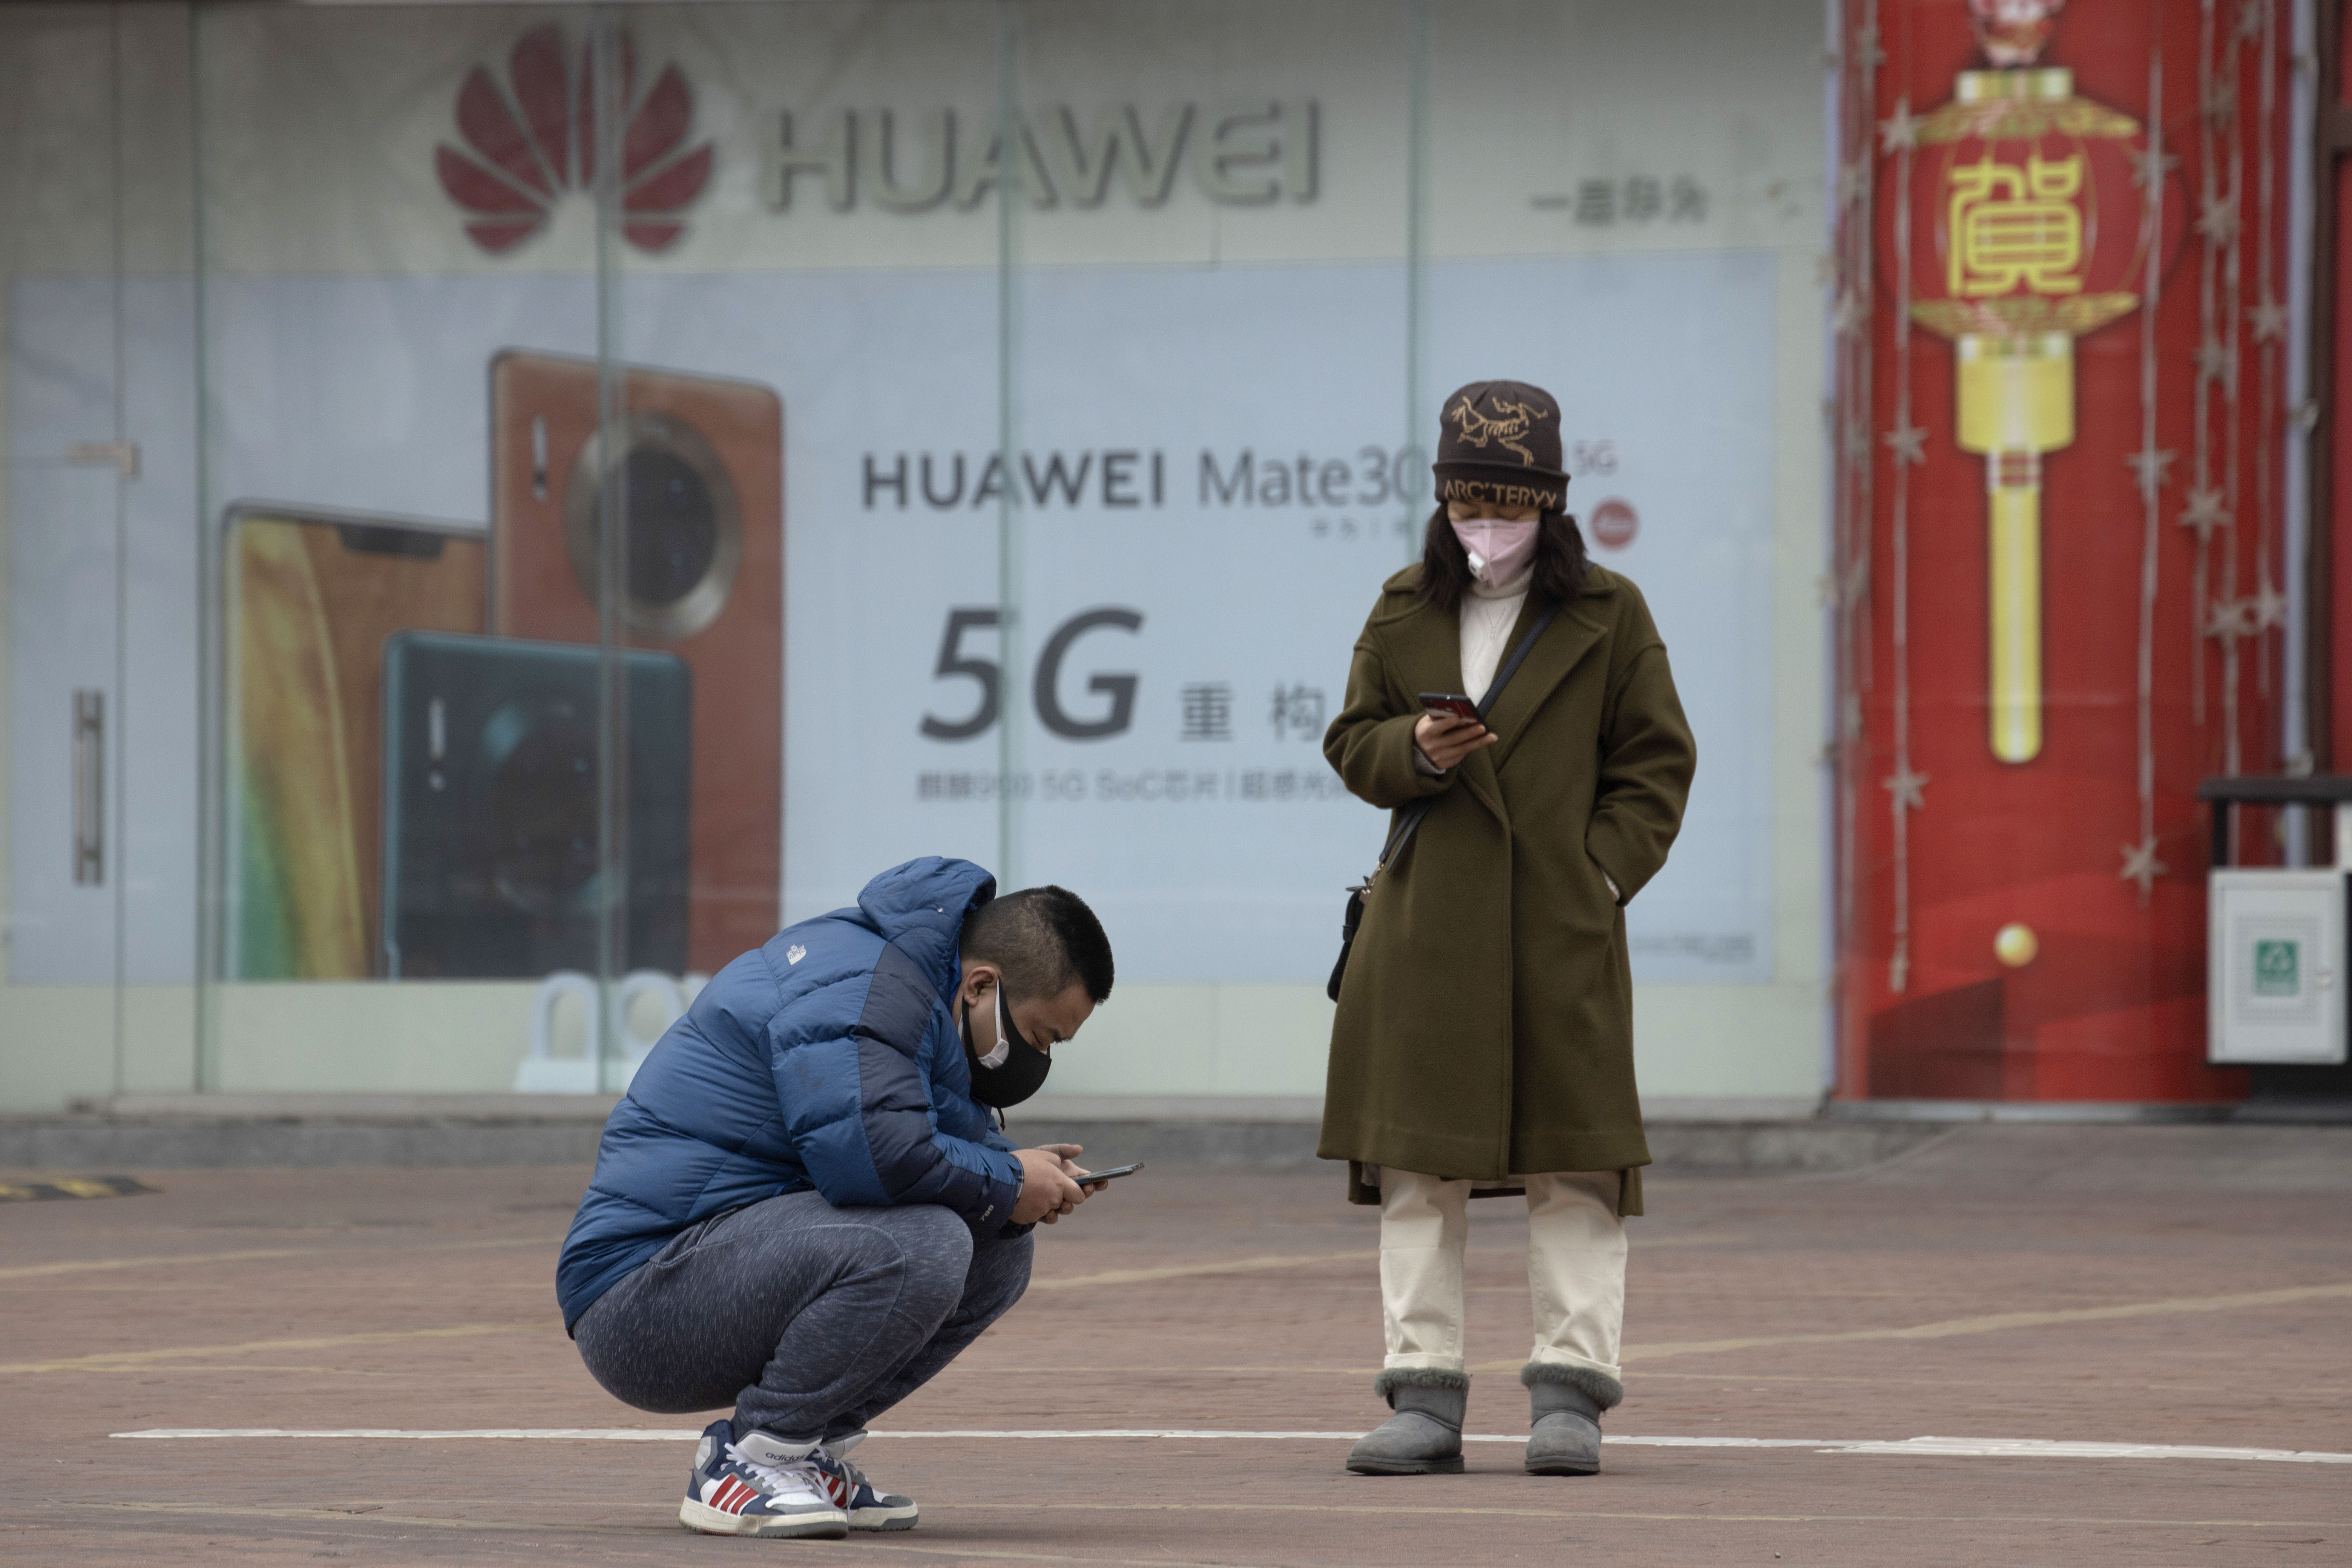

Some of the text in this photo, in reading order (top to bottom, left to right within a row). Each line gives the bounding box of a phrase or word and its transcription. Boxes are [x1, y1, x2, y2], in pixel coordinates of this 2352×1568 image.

[760, 97, 1321, 213] HUAWEI
[861, 449, 1165, 510] HUAWEI
[1198, 443, 1431, 508] Mate30
[917, 605, 1145, 744] 5G
[980, 1205, 994, 1222] 700
